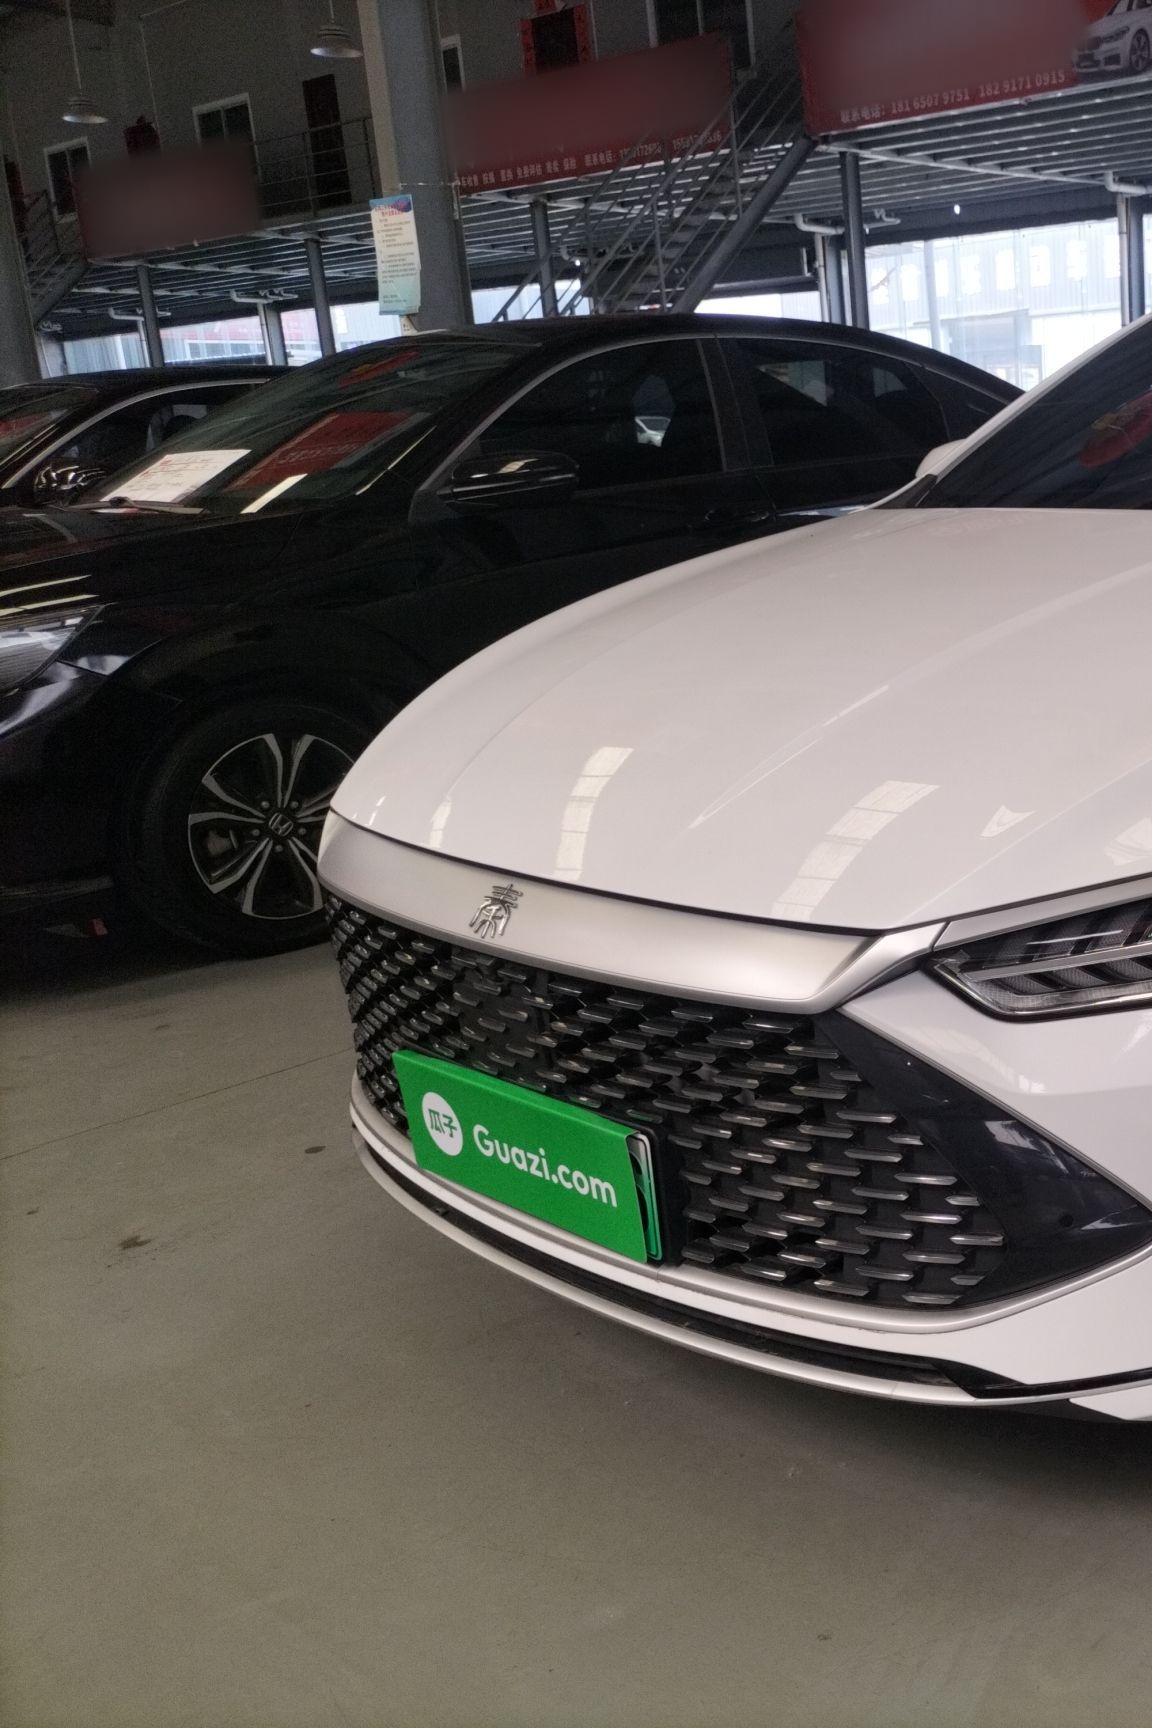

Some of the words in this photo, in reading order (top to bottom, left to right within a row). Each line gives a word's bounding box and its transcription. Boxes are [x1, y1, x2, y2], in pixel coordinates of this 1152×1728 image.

[891, 100, 911, 115] 181
[913, 95, 939, 111] 6507
[943, 88, 970, 105] 9751
[979, 82, 1000, 99] 182
[1003, 76, 1031, 94] 9171
[1035, 70, 1065, 88] 0915
[428, 1108, 457, 1138] 瓜子
[473, 1123, 618, 1208] Guazi.com
